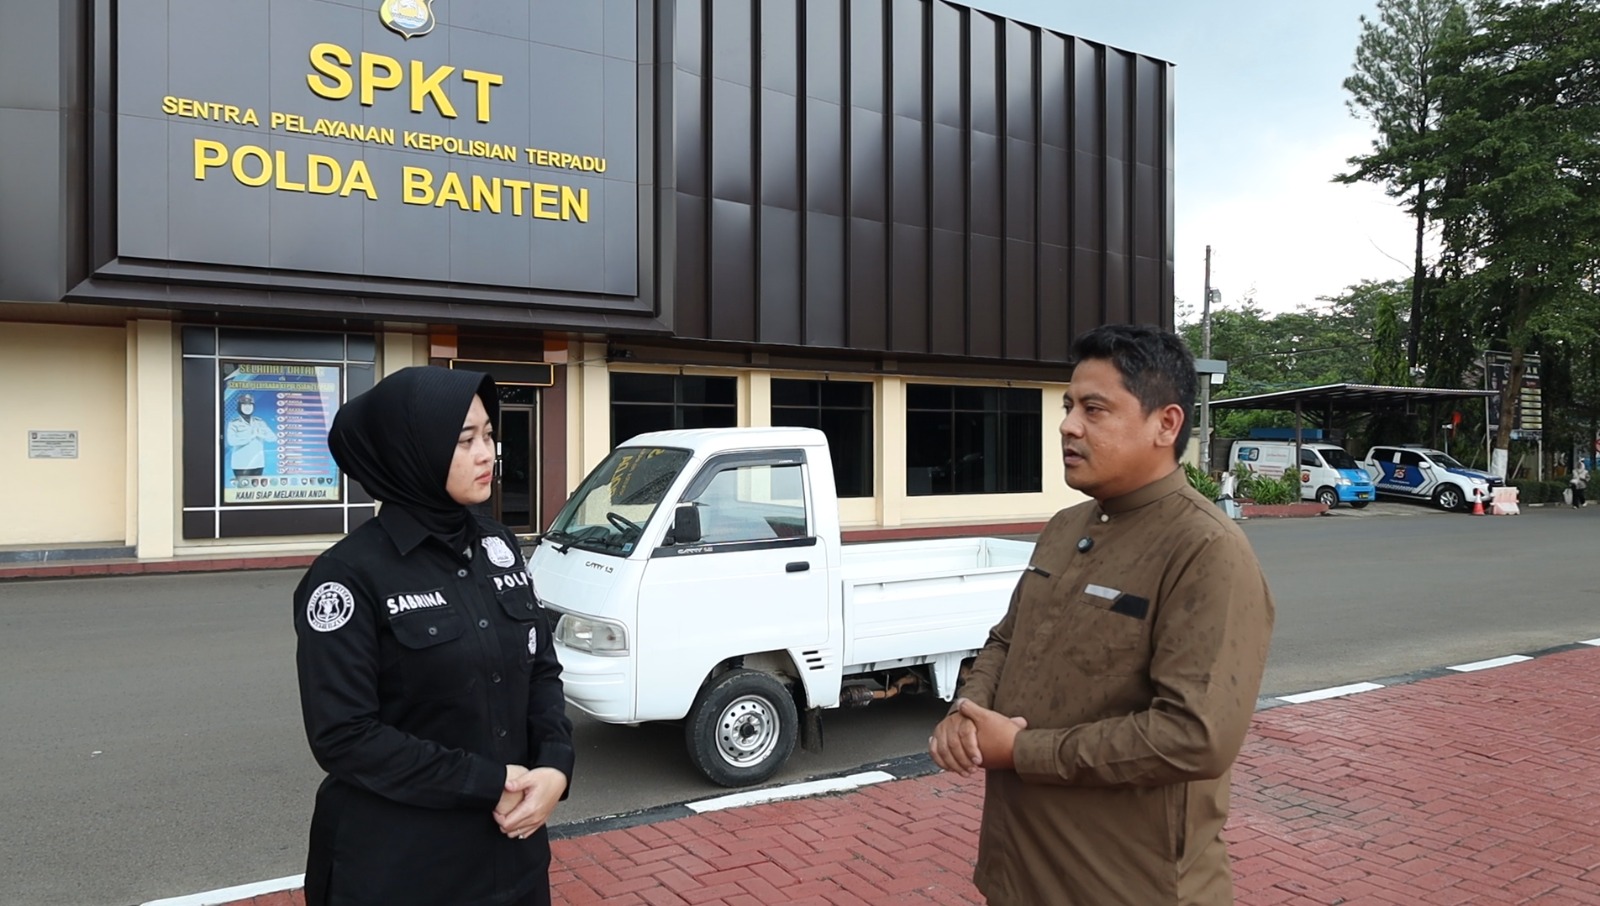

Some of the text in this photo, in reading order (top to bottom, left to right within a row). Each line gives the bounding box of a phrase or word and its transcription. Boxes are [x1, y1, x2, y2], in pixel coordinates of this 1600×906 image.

[306, 43, 504, 123] SPKT
[162, 96, 607, 172] SENTRA PELAYANAN KEPOLISIAN TERPADU
[193, 139, 590, 222] POLDA BANTEN
[235, 489, 327, 500] KAMI SIAP MELAYANI ANDA
[386, 591, 448, 615] SABRINA
